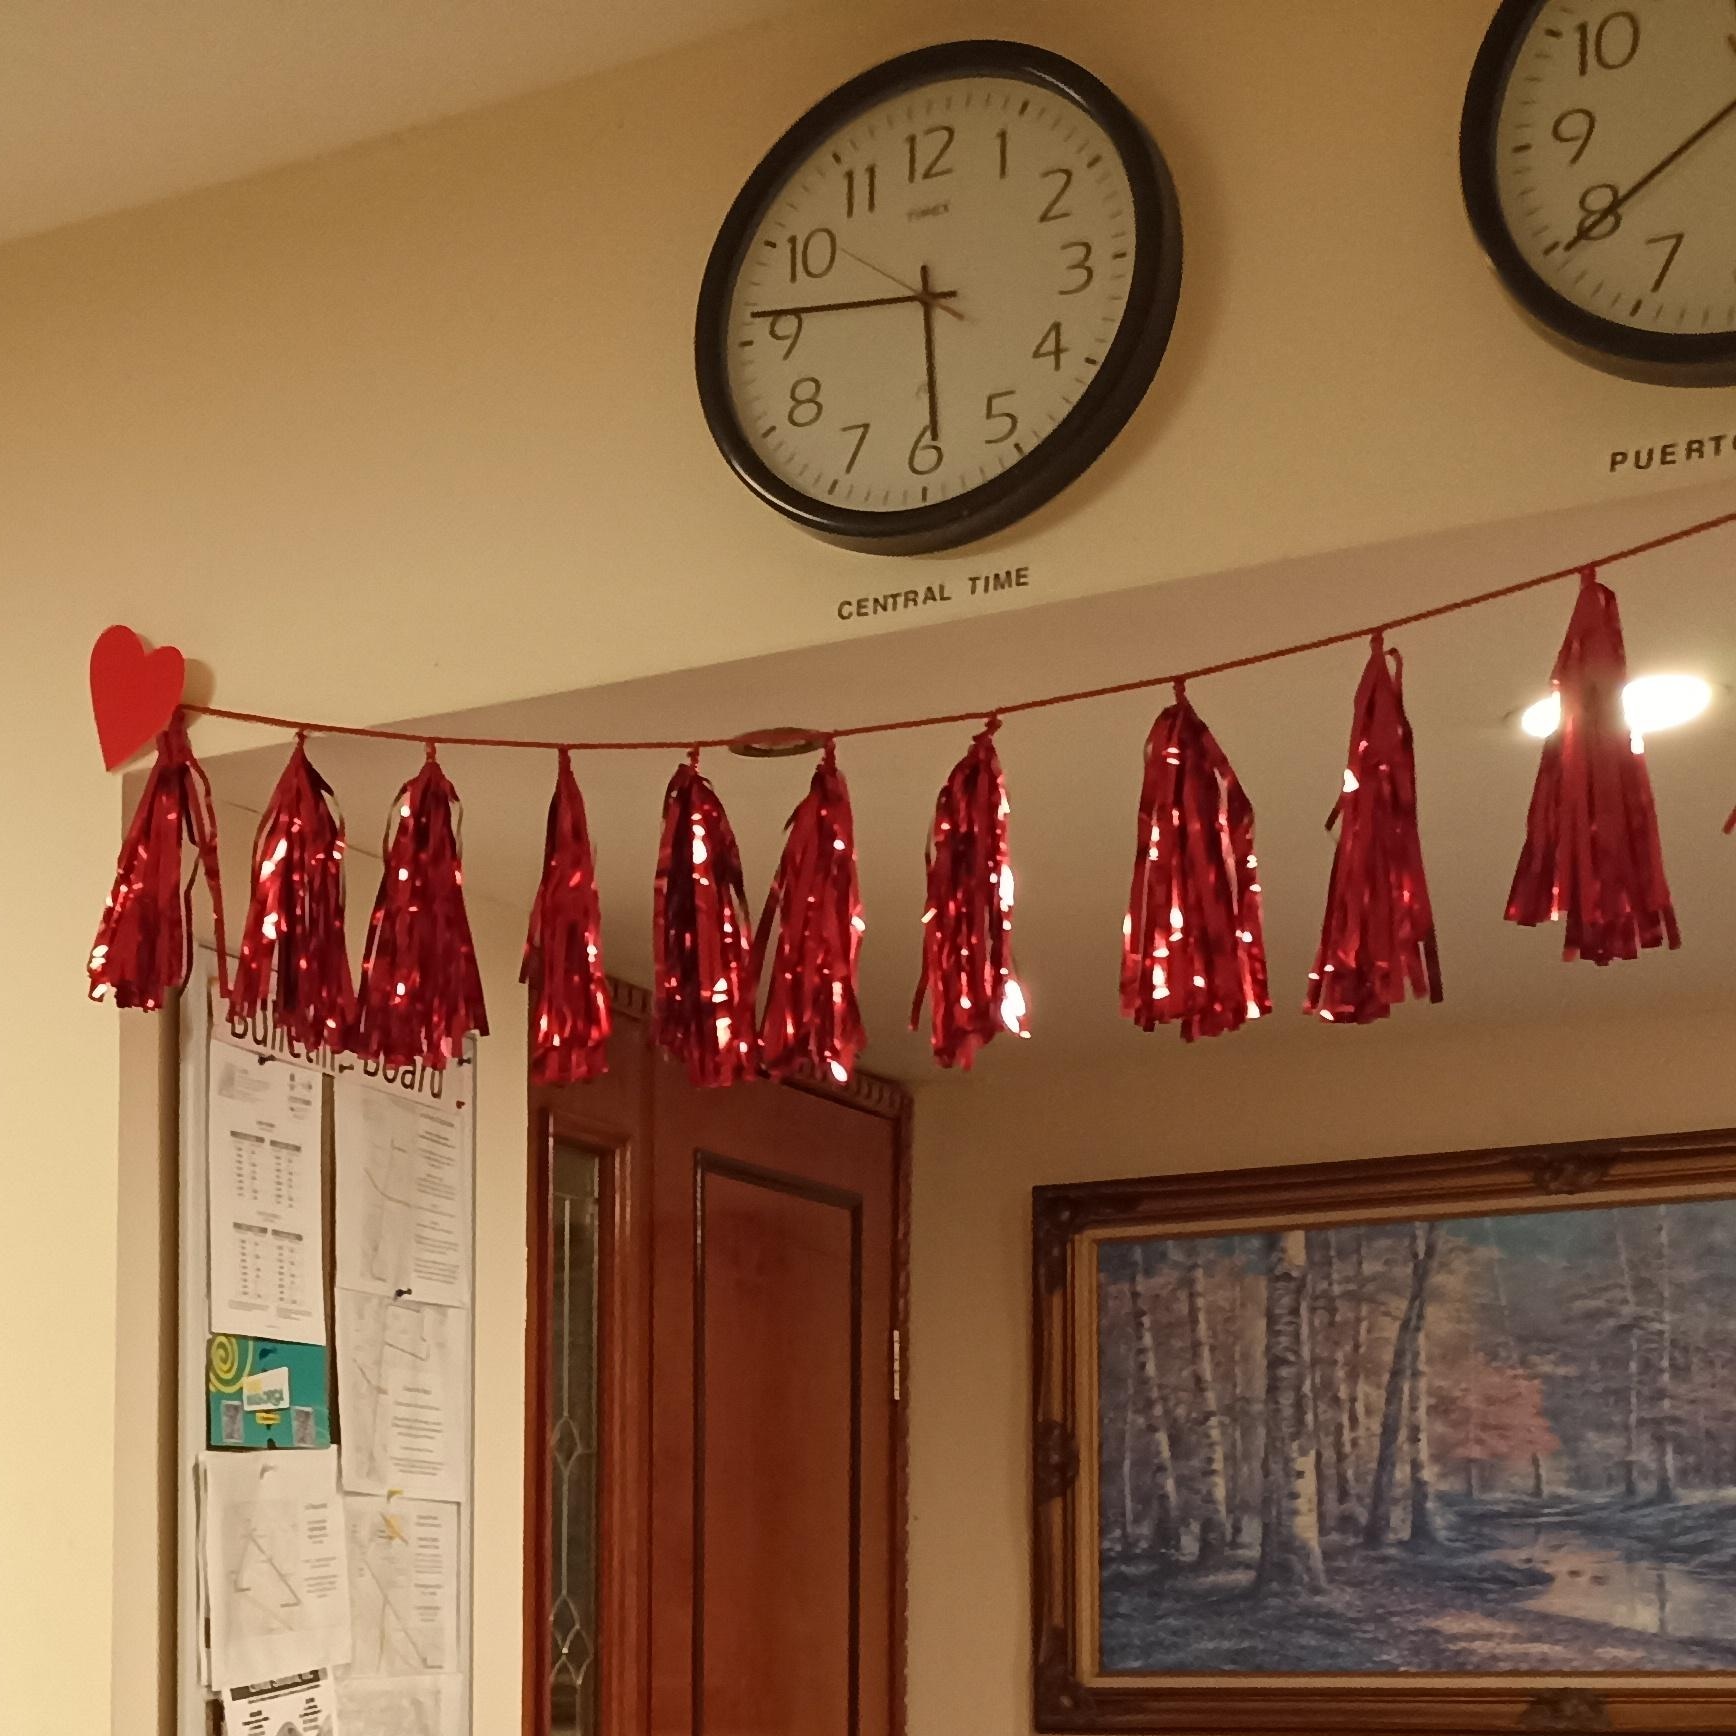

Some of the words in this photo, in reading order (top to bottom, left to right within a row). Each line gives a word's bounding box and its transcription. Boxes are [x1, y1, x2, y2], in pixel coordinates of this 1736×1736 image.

[1576, 11, 1641, 76] 10
[905, 126, 956, 183] 12
[996, 128, 1009, 180] 1
[1552, 109, 1596, 165] 9
[844, 163, 876, 218] 11
[1038, 168, 1074, 222] 2
[1577, 184, 1622, 241] 8
[786, 226, 837, 283] 10
[1059, 242, 1094, 295] 3
[1646, 232, 1685, 293] 7
[767, 314, 804, 360] 9
[1032, 322, 1069, 371] 4
[788, 377, 824, 427] 8
[985, 391, 1019, 444] 5
[840, 423, 871, 474] 7
[908, 424, 944, 476] 6
[1610, 434, 1736, 473] PUERT
[838, 584, 951, 620] CENTRAL
[968, 567, 1029, 595] TIME
